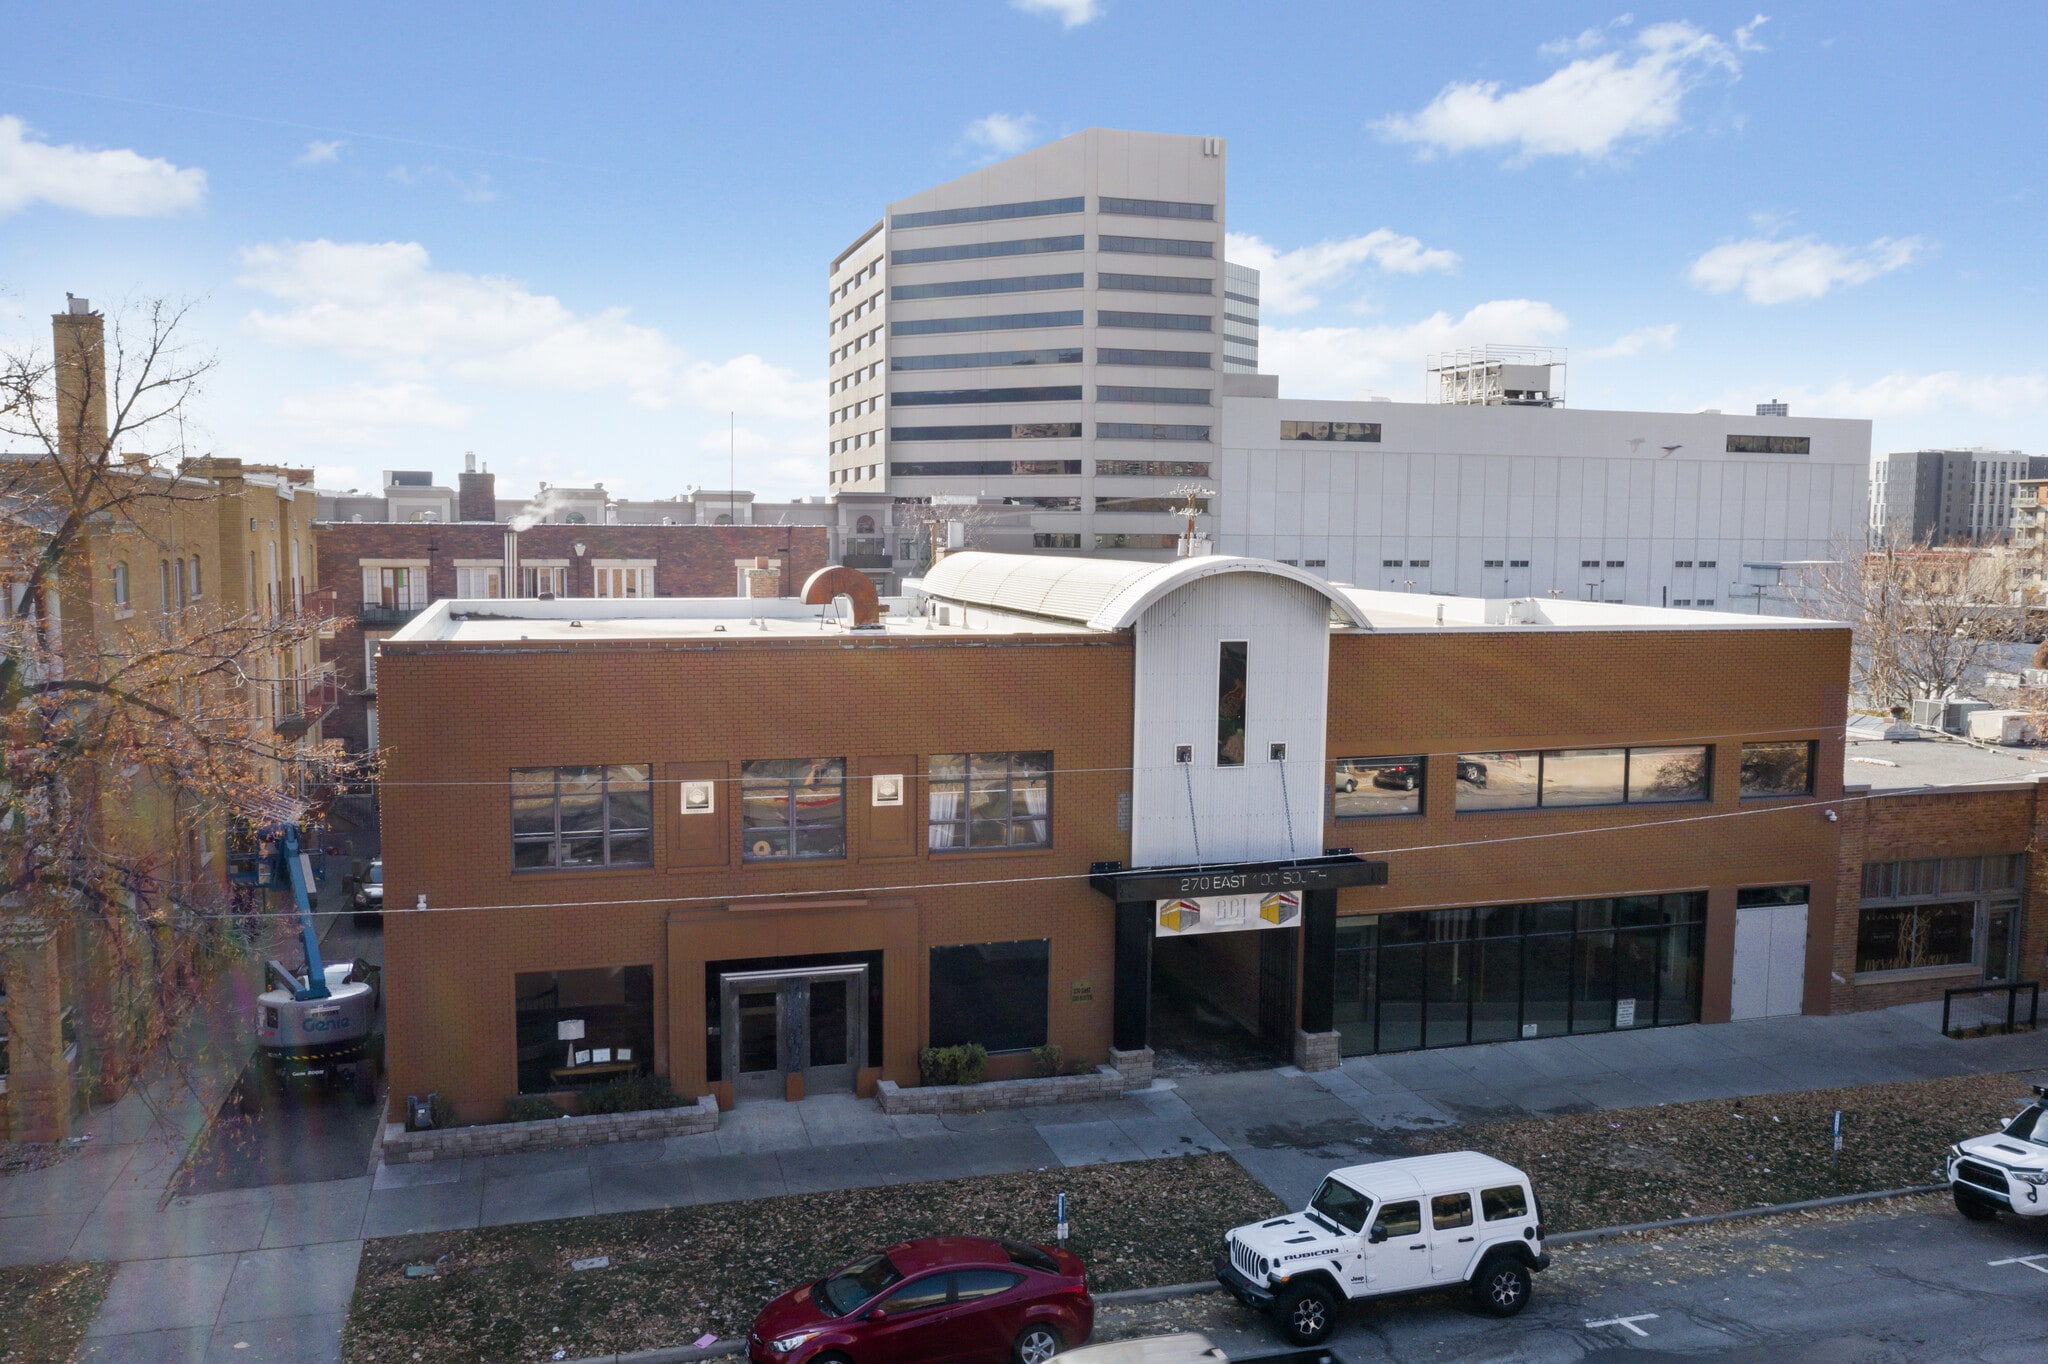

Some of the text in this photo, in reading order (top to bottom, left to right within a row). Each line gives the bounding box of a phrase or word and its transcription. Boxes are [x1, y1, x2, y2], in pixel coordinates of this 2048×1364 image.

[1180, 877, 1210, 892] 270
[1213, 874, 1248, 890] EAST
[302, 1017, 351, 1032] Genie
[1284, 1248, 1339, 1261] RUBICON
